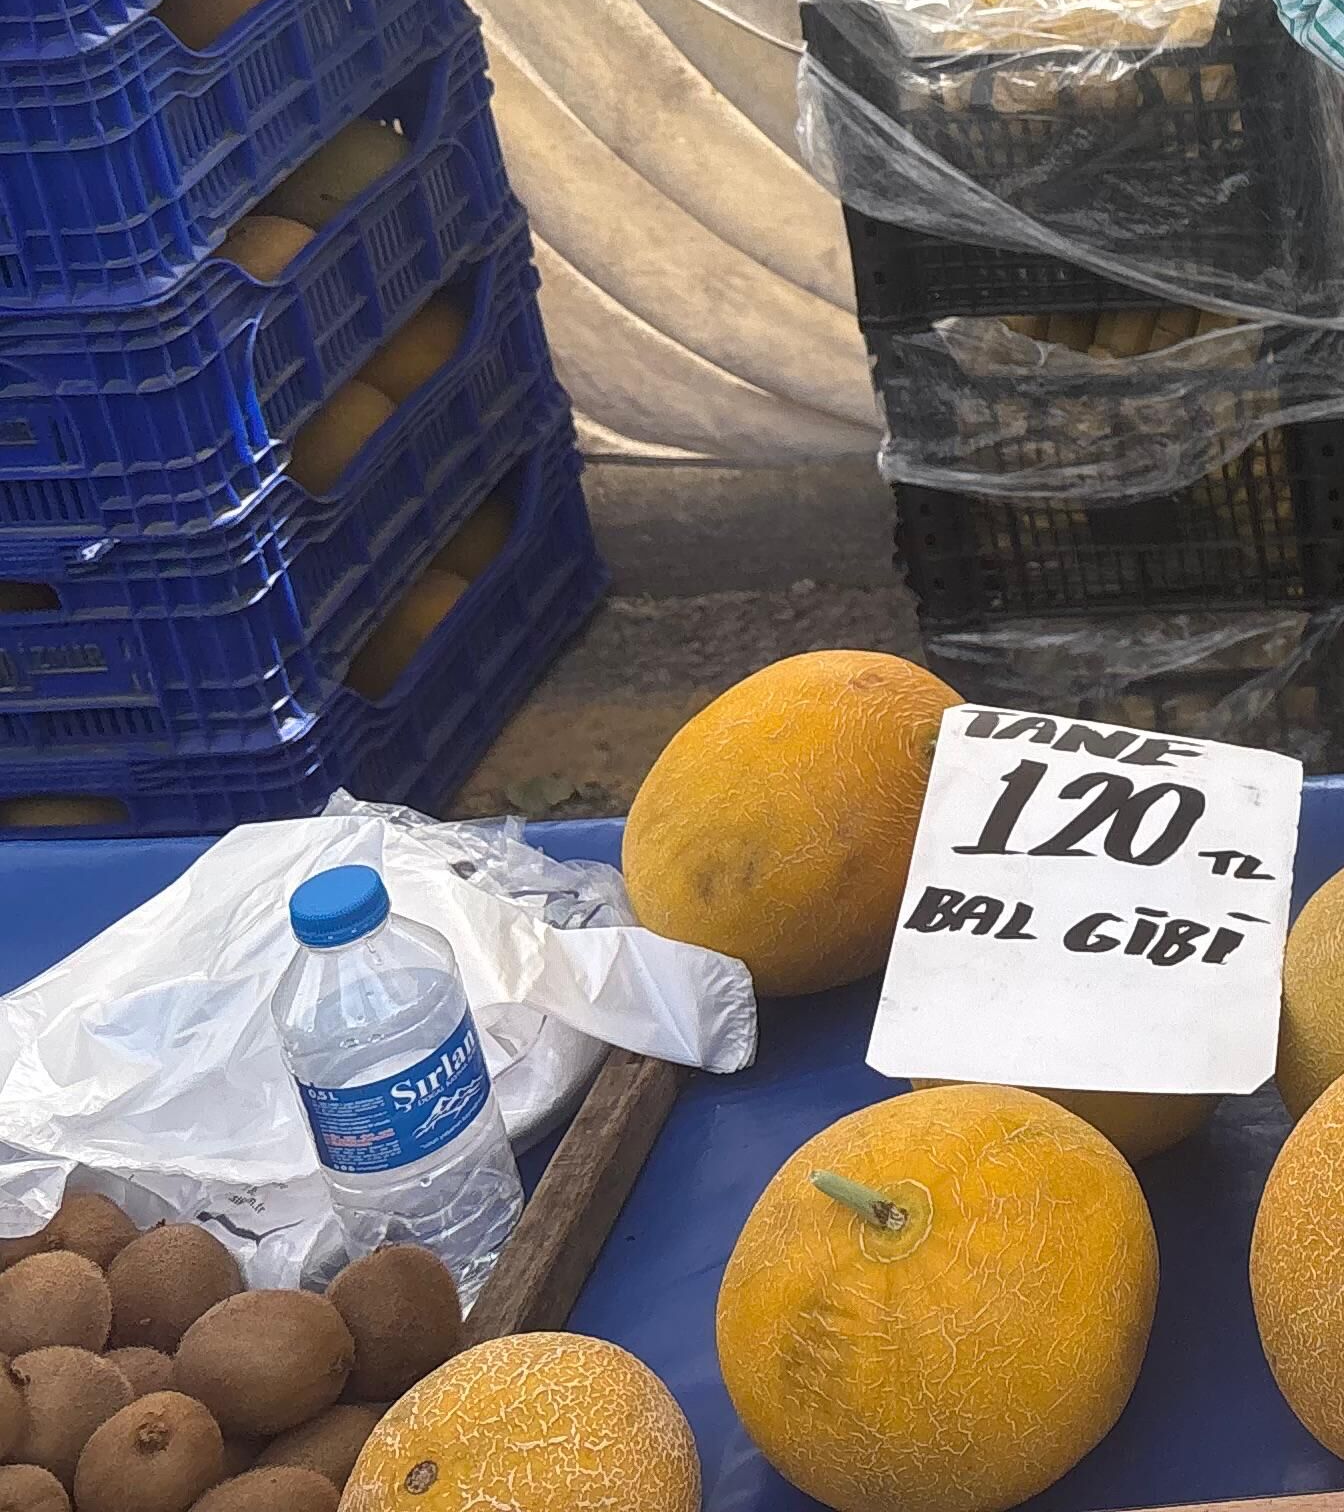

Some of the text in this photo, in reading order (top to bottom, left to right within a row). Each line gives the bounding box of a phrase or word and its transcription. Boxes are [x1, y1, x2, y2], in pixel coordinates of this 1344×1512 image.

[960, 709, 1206, 768] TANE
[951, 758, 1277, 880] 120 TL
[903, 885, 1272, 968] BAL GİBİ
